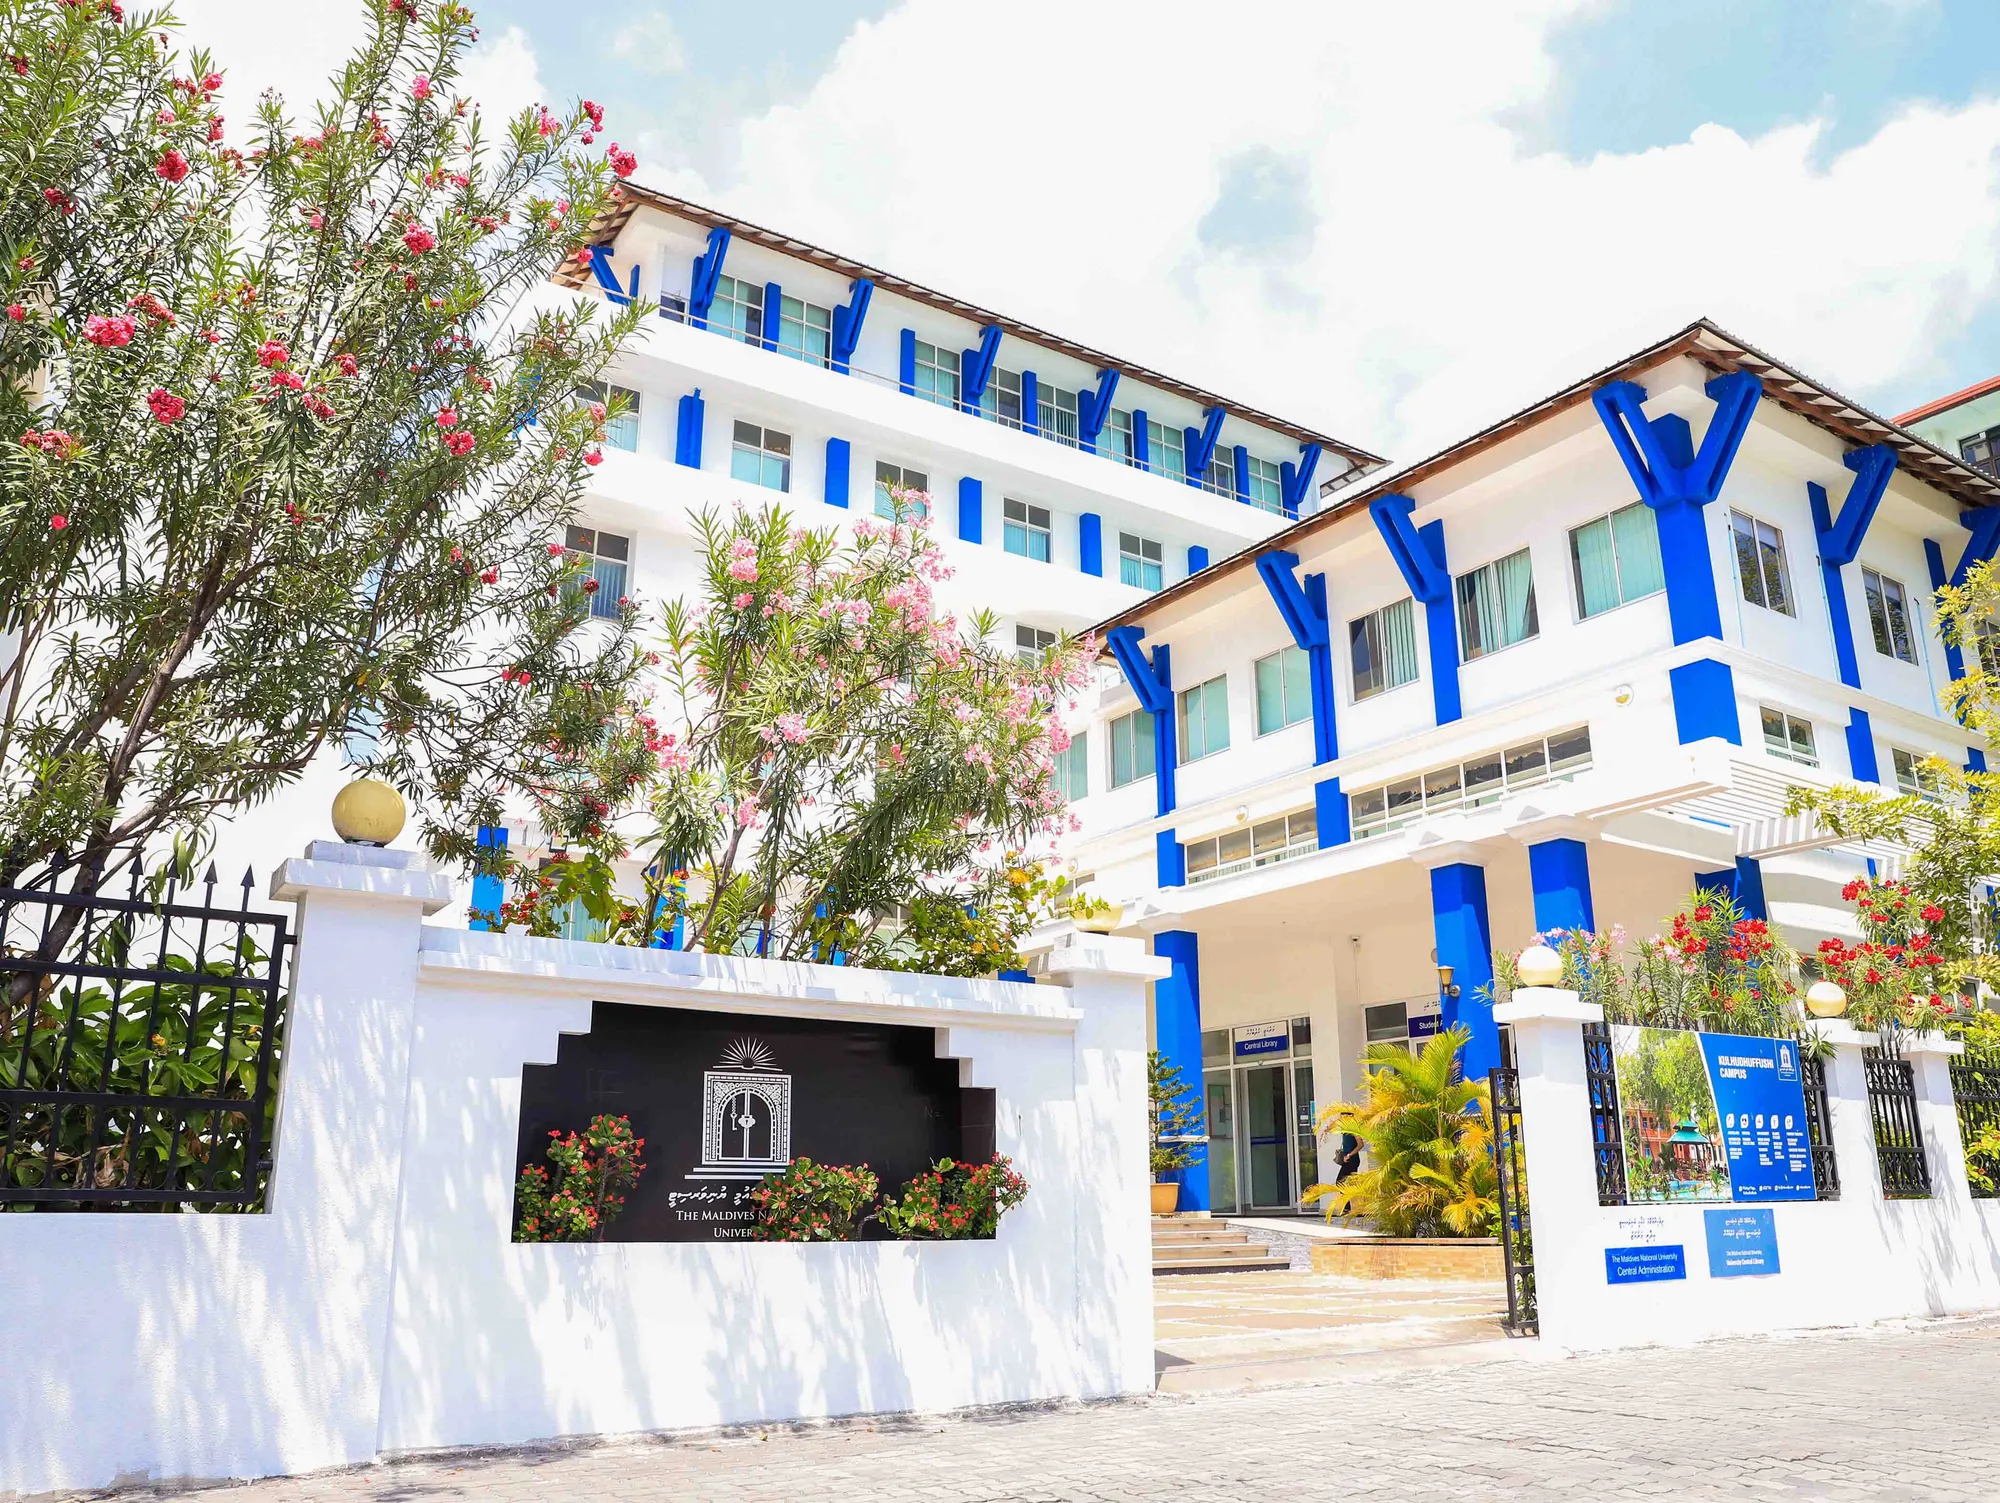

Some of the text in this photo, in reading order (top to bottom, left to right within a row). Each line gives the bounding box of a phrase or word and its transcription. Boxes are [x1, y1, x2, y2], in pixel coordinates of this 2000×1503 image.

[1244, 1040, 1278, 1050] Central Library
[1718, 1055, 1774, 1069] KULHUDHUFFUSHI
[1720, 1068, 1747, 1079] CAMPUS
[714, 1227, 754, 1238] UNIVER
[1611, 1252, 1678, 1263] The Maldives National University
[1617, 1264, 1676, 1276] Central Administration
